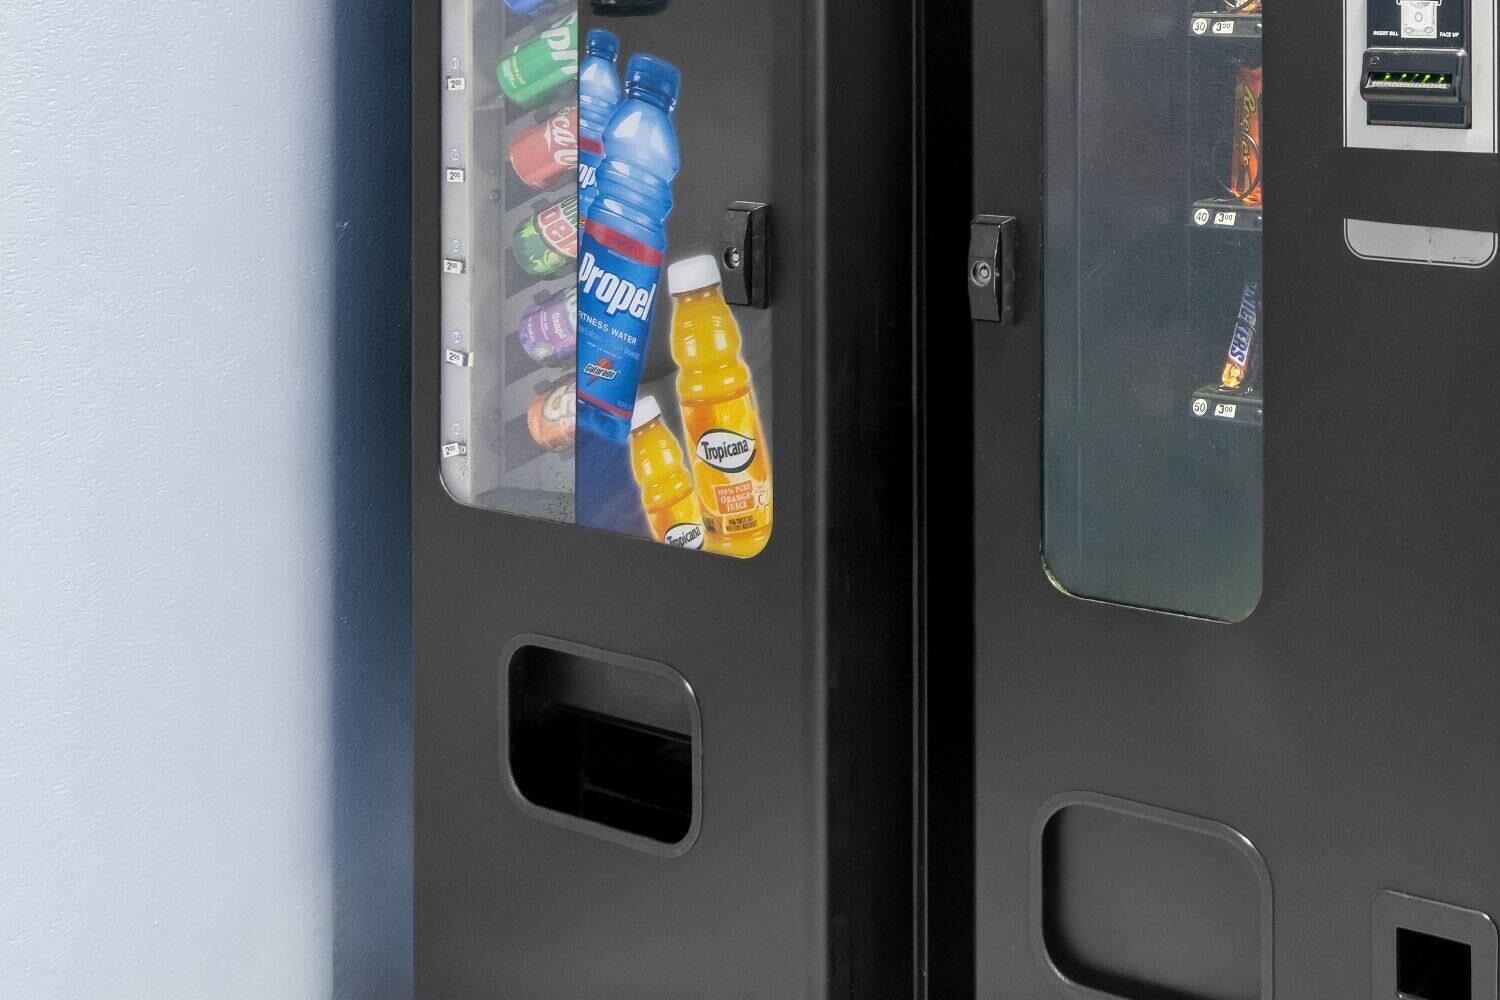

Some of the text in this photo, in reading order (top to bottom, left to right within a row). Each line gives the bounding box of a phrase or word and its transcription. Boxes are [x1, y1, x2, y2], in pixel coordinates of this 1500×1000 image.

[1194, 21, 1206, 31] 30
[1195, 212, 1208, 222] 40
[578, 251, 657, 322] Propel
[610, 327, 638, 346] WATER
[1193, 402, 1206, 413] 50
[700, 439, 750, 463] Tropicana
[720, 491, 753, 504] ORANGE
[727, 501, 749, 513] JUICE
